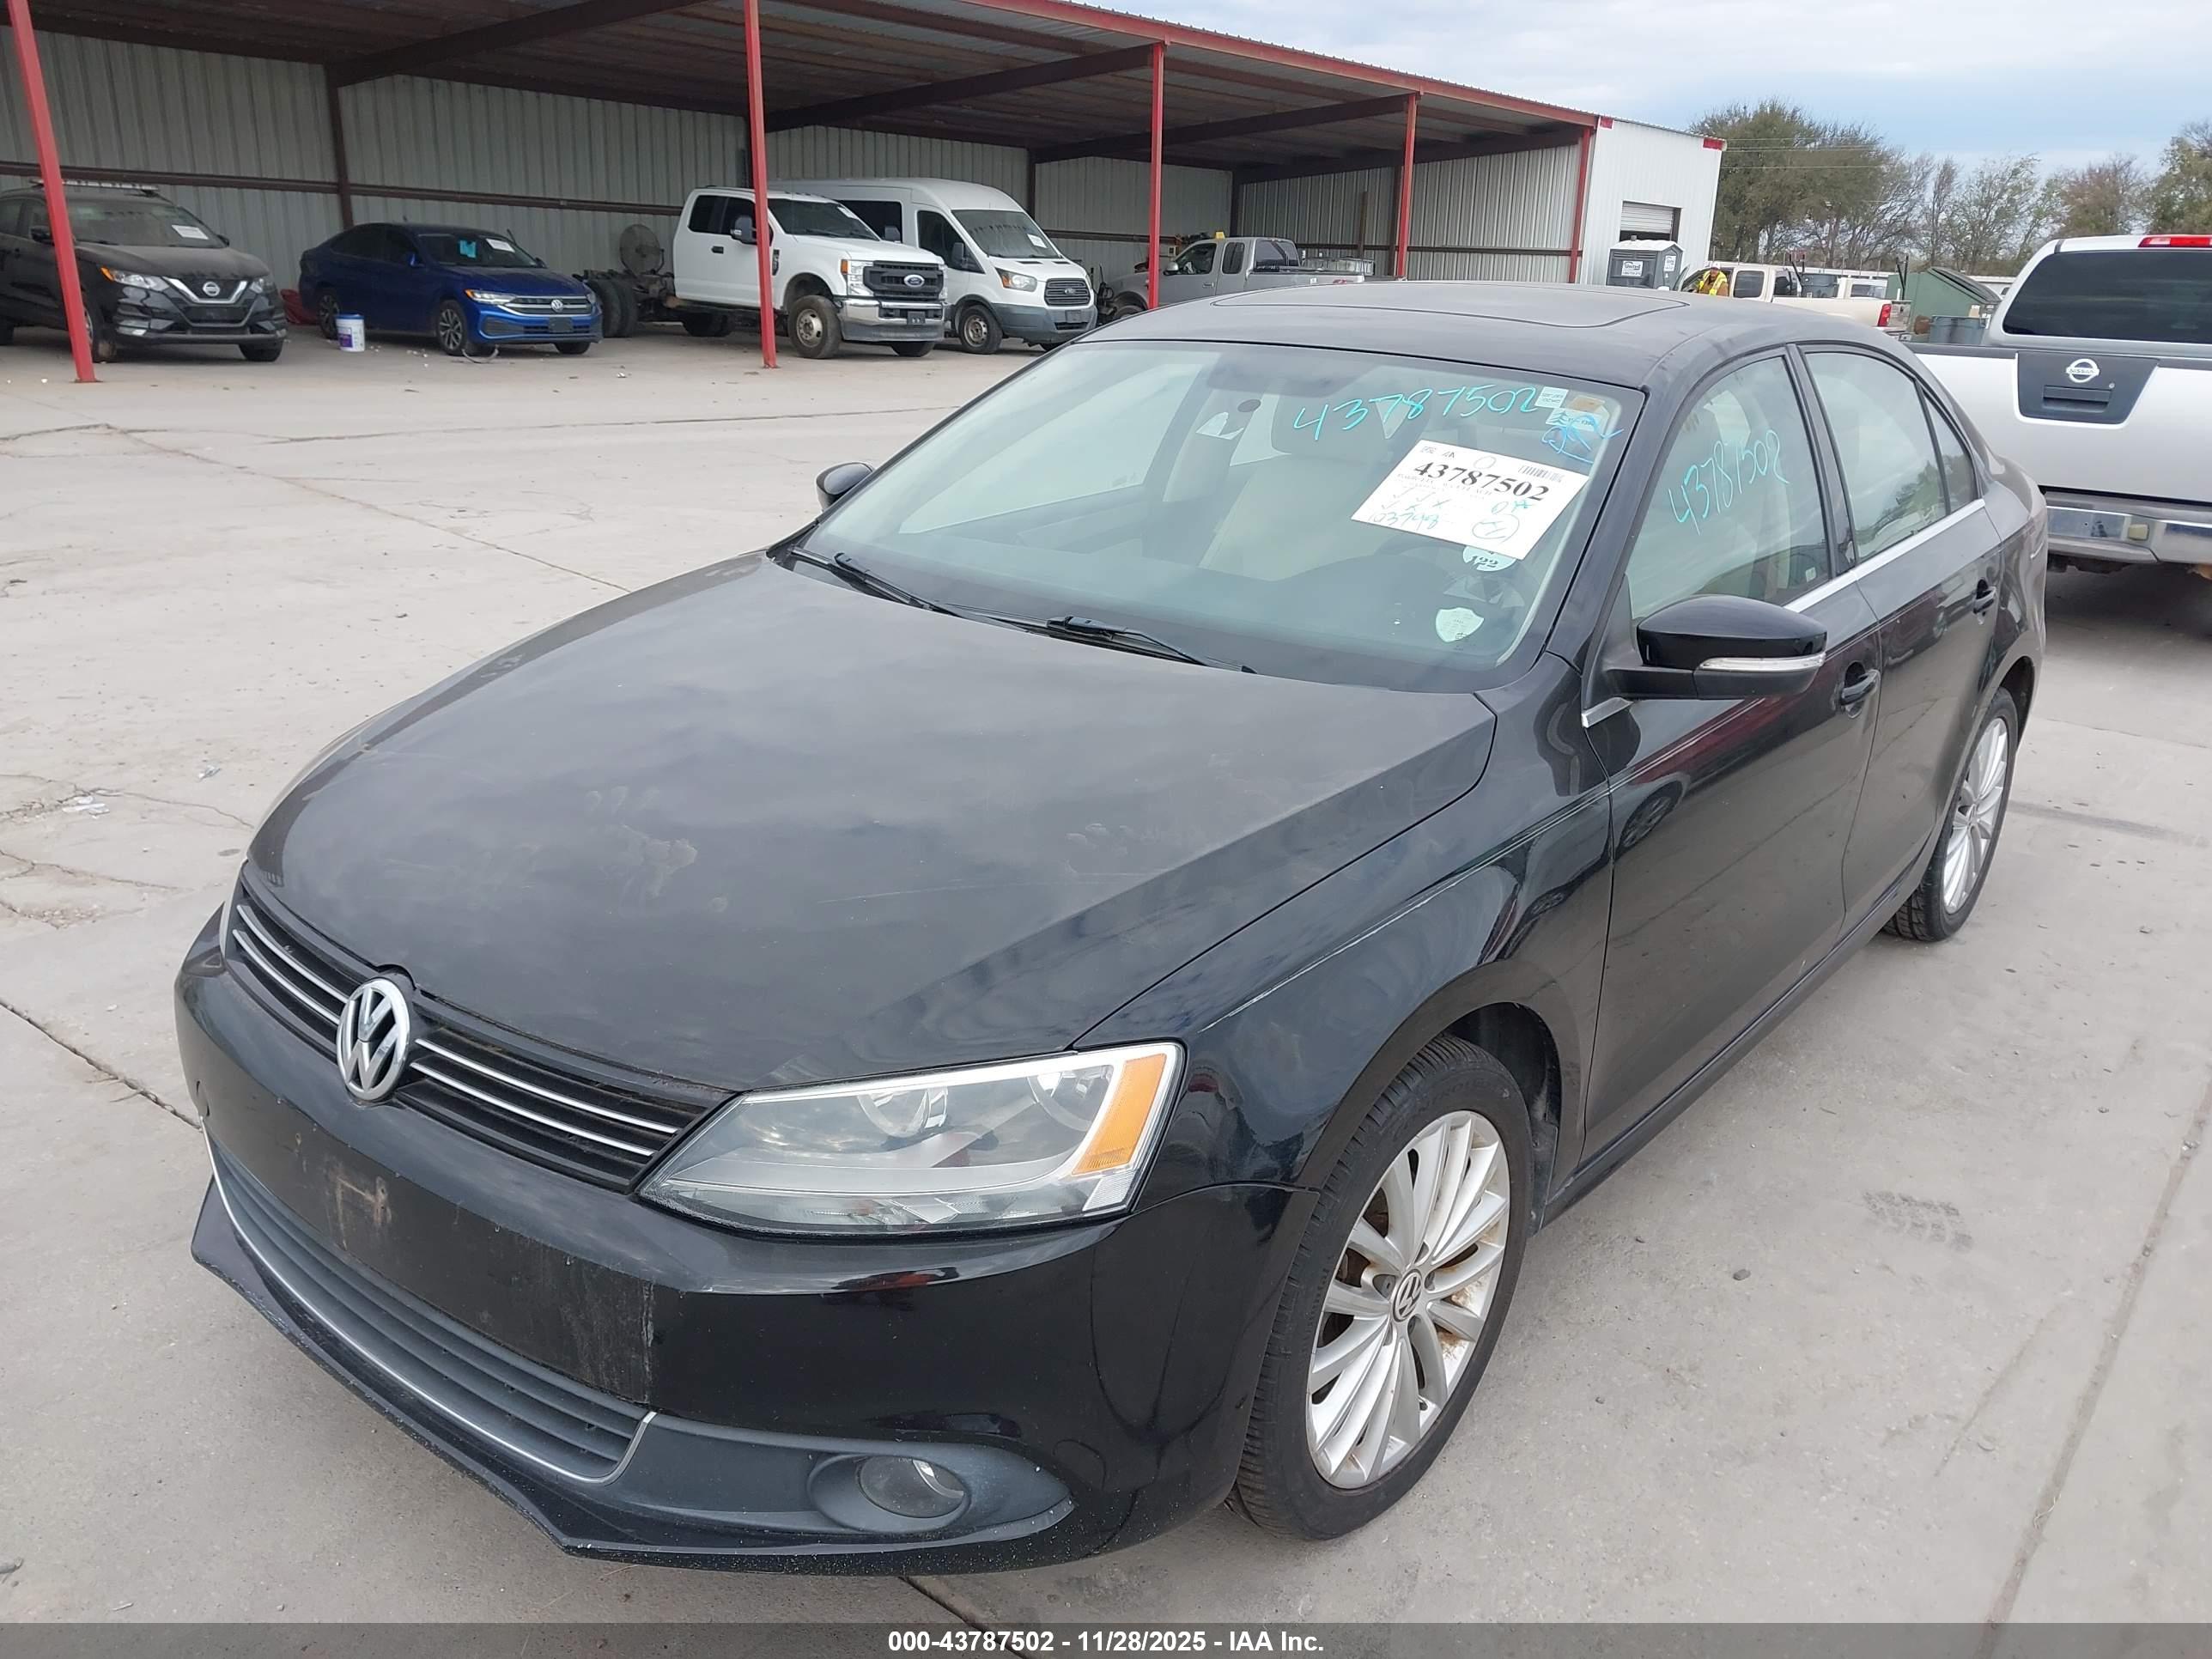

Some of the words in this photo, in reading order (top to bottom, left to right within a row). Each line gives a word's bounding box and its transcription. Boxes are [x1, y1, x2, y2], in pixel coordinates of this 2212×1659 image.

[1292, 384, 1540, 441] 43787502
[1413, 462, 1549, 501] 43787502
[1668, 429, 1790, 537] 43787502
